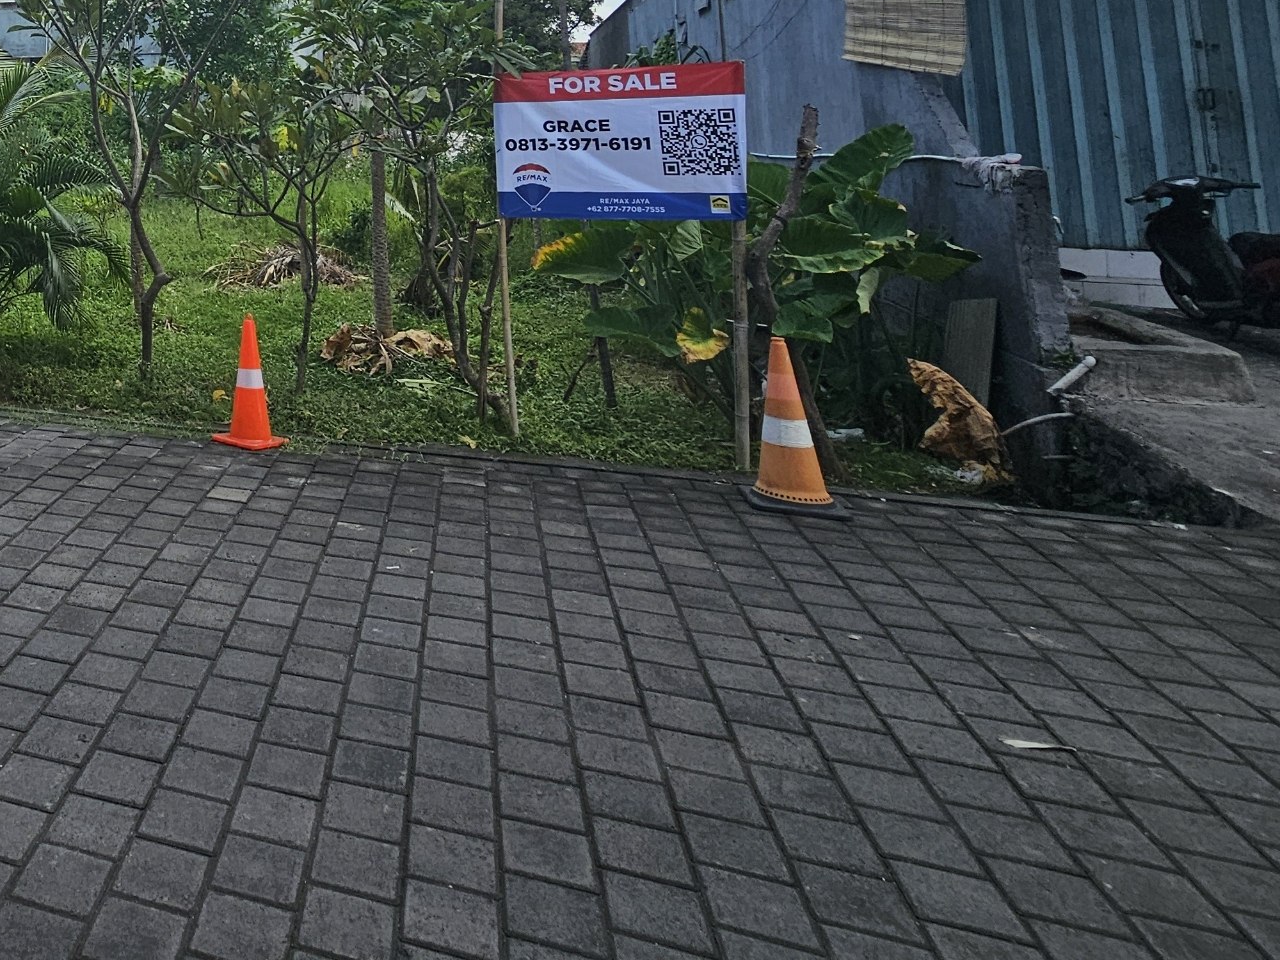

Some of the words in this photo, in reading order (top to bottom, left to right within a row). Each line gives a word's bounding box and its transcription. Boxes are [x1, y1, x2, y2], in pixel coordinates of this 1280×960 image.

[548, 75, 601, 94] FOR
[607, 72, 677, 91] SALE
[543, 119, 611, 133] GRACE
[505, 137, 651, 152] 0813-3971-6191
[516, 174, 548, 182] RE/MAX
